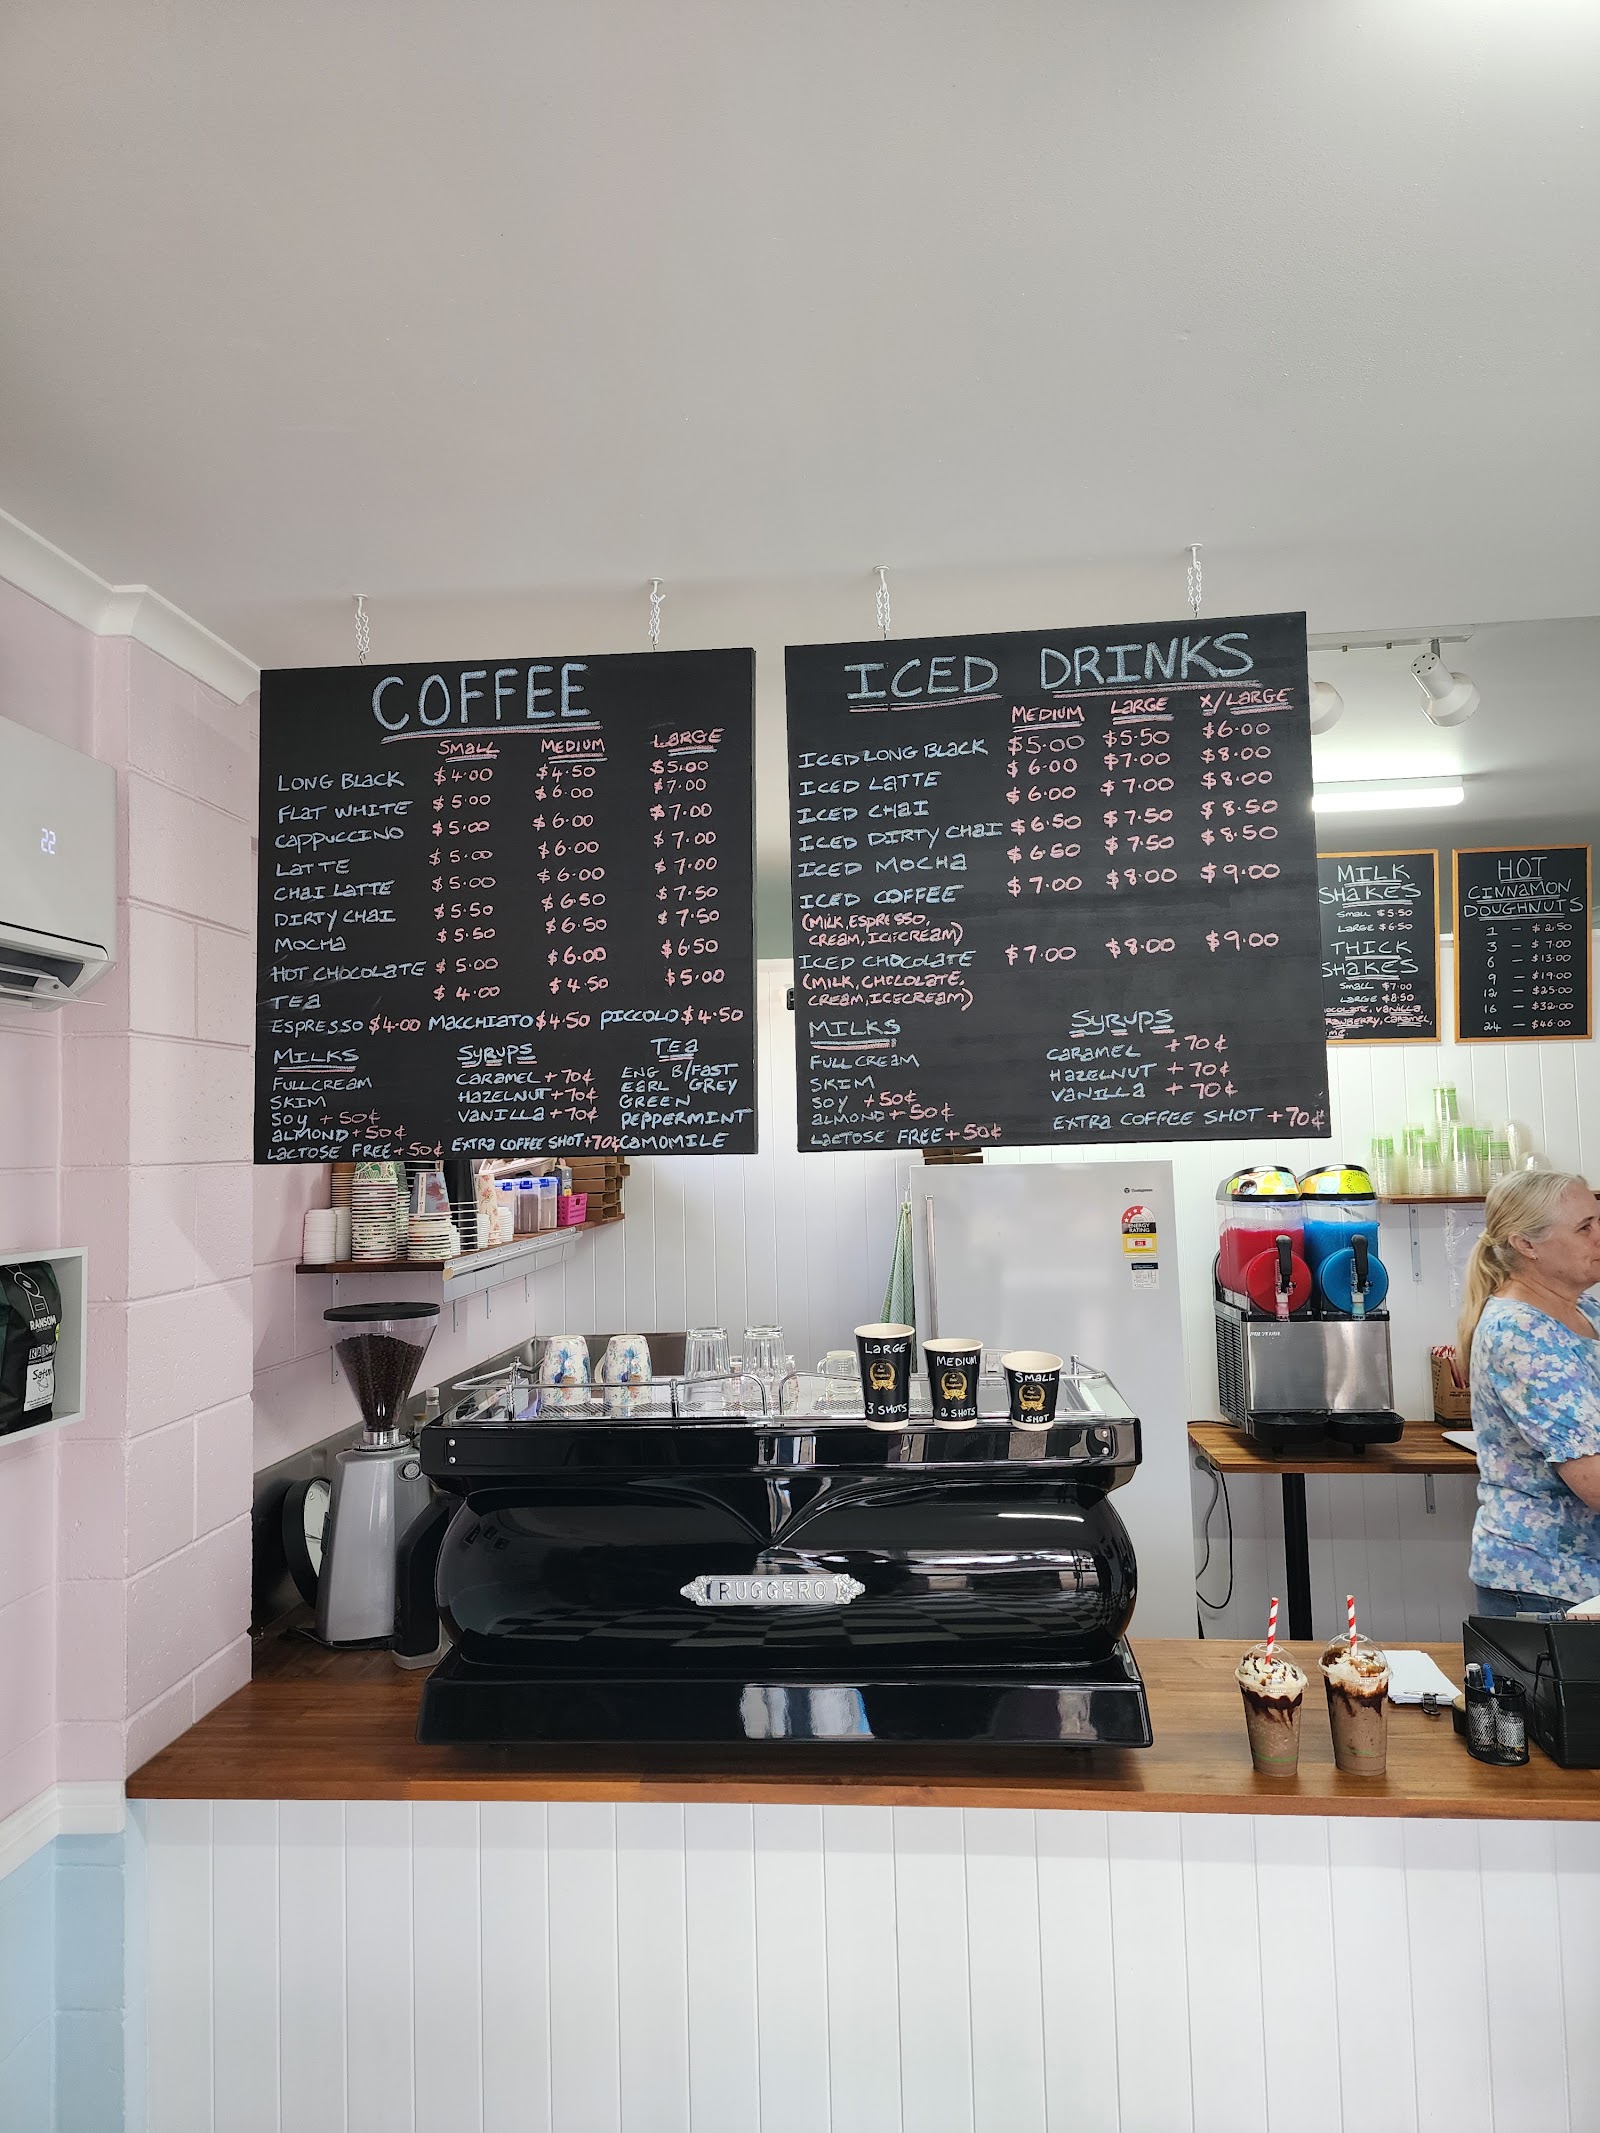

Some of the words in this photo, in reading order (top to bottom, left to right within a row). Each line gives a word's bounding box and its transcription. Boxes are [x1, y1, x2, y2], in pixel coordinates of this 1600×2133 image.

[845, 656, 999, 700] ICED
[1041, 633, 1254, 693] DRINKS
[372, 663, 591, 731] COFFEE
[1012, 706, 1084, 725] MEDIUM
[541, 738, 605, 753] MEDIUM
[798, 753, 860, 768] ICED
[863, 746, 918, 761] LONG
[278, 775, 333, 791] LONG
[799, 780, 859, 795] ICED
[335, 801, 413, 818] WHITE
[797, 807, 857, 824] ICED
[41, 828, 56, 854] 22
[799, 835, 857, 852] ICED
[868, 828, 939, 849] DIRTY
[798, 862, 862, 877] ICED
[1338, 864, 1410, 882] MILK
[1498, 856, 1548, 880] HOT
[800, 893, 860, 909] ICED
[874, 885, 964, 904] COFFEE
[1464, 896, 1584, 918] DOUGHNUTS
[275, 910, 337, 932] DIRTY
[1485, 926, 1499, 937] 1
[1331, 941, 1412, 955] THICK
[1486, 941, 1498, 953] 3
[799, 955, 855, 970] ICED
[1486, 955, 1495, 969] 6
[270, 966, 309, 982] HOT
[1487, 973, 1497, 986] 9
[1483, 987, 1498, 998] 12
[1484, 1003, 1498, 1014] 16
[270, 1019, 363, 1038] ESPRESSO
[601, 1009, 679, 1030] PICCOLO
[809, 1019, 900, 1037] MILKS
[1483, 1020, 1502, 1033] 24
[274, 1048, 359, 1064] MILKS
[621, 1067, 659, 1078] ENG
[689, 1078, 737, 1095] GREY
[810, 1076, 875, 1092] SKIM
[270, 1096, 326, 1109] SKIM
[619, 1094, 690, 1108] GREEN
[1120, 1110, 1196, 1125] COFFEE
[1204, 1108, 1264, 1124] SHOT
[500, 1137, 546, 1150] COFFEE
[548, 1133, 584, 1149] SHOT
[898, 1128, 944, 1144] FREE
[352, 1143, 391, 1159] FREE
[937, 1356, 977, 1366] MEDIUM
[867, 1402, 874, 1414] 3
[878, 1403, 907, 1414] SHOTS
[941, 1408, 948, 1417] 2
[951, 1407, 975, 1417] SHOTS
[1026, 1414, 1049, 1423] SHOT
[719, 1581, 827, 1600] RUGGERO
